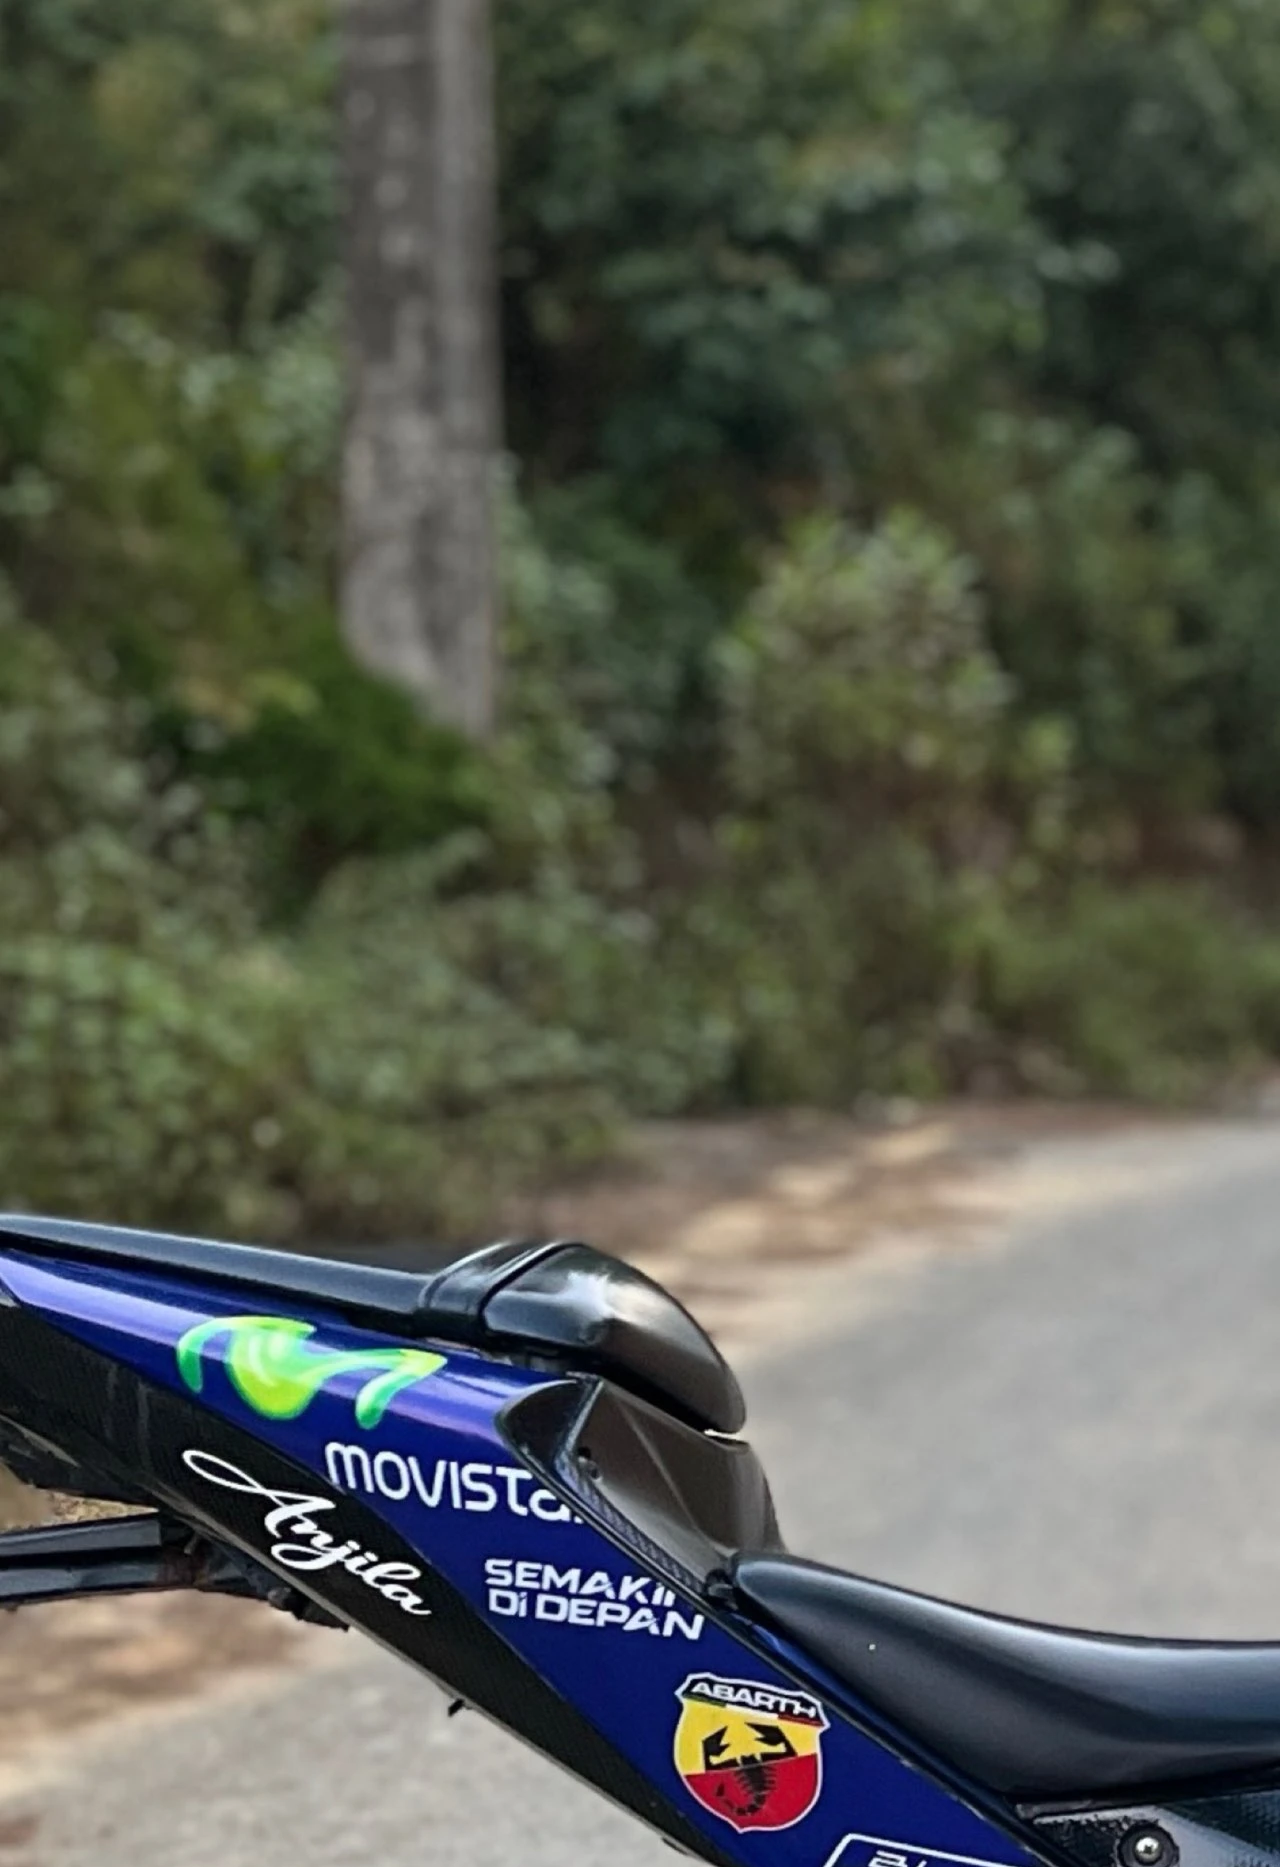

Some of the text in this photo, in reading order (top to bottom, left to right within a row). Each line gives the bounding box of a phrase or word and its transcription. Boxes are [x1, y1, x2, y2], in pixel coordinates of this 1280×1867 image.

[325, 1442, 583, 1524] movista
[182, 1450, 432, 1615] Anjila
[535, 1594, 705, 1640] DEPAN
[690, 1681, 818, 1719] ABARTH
